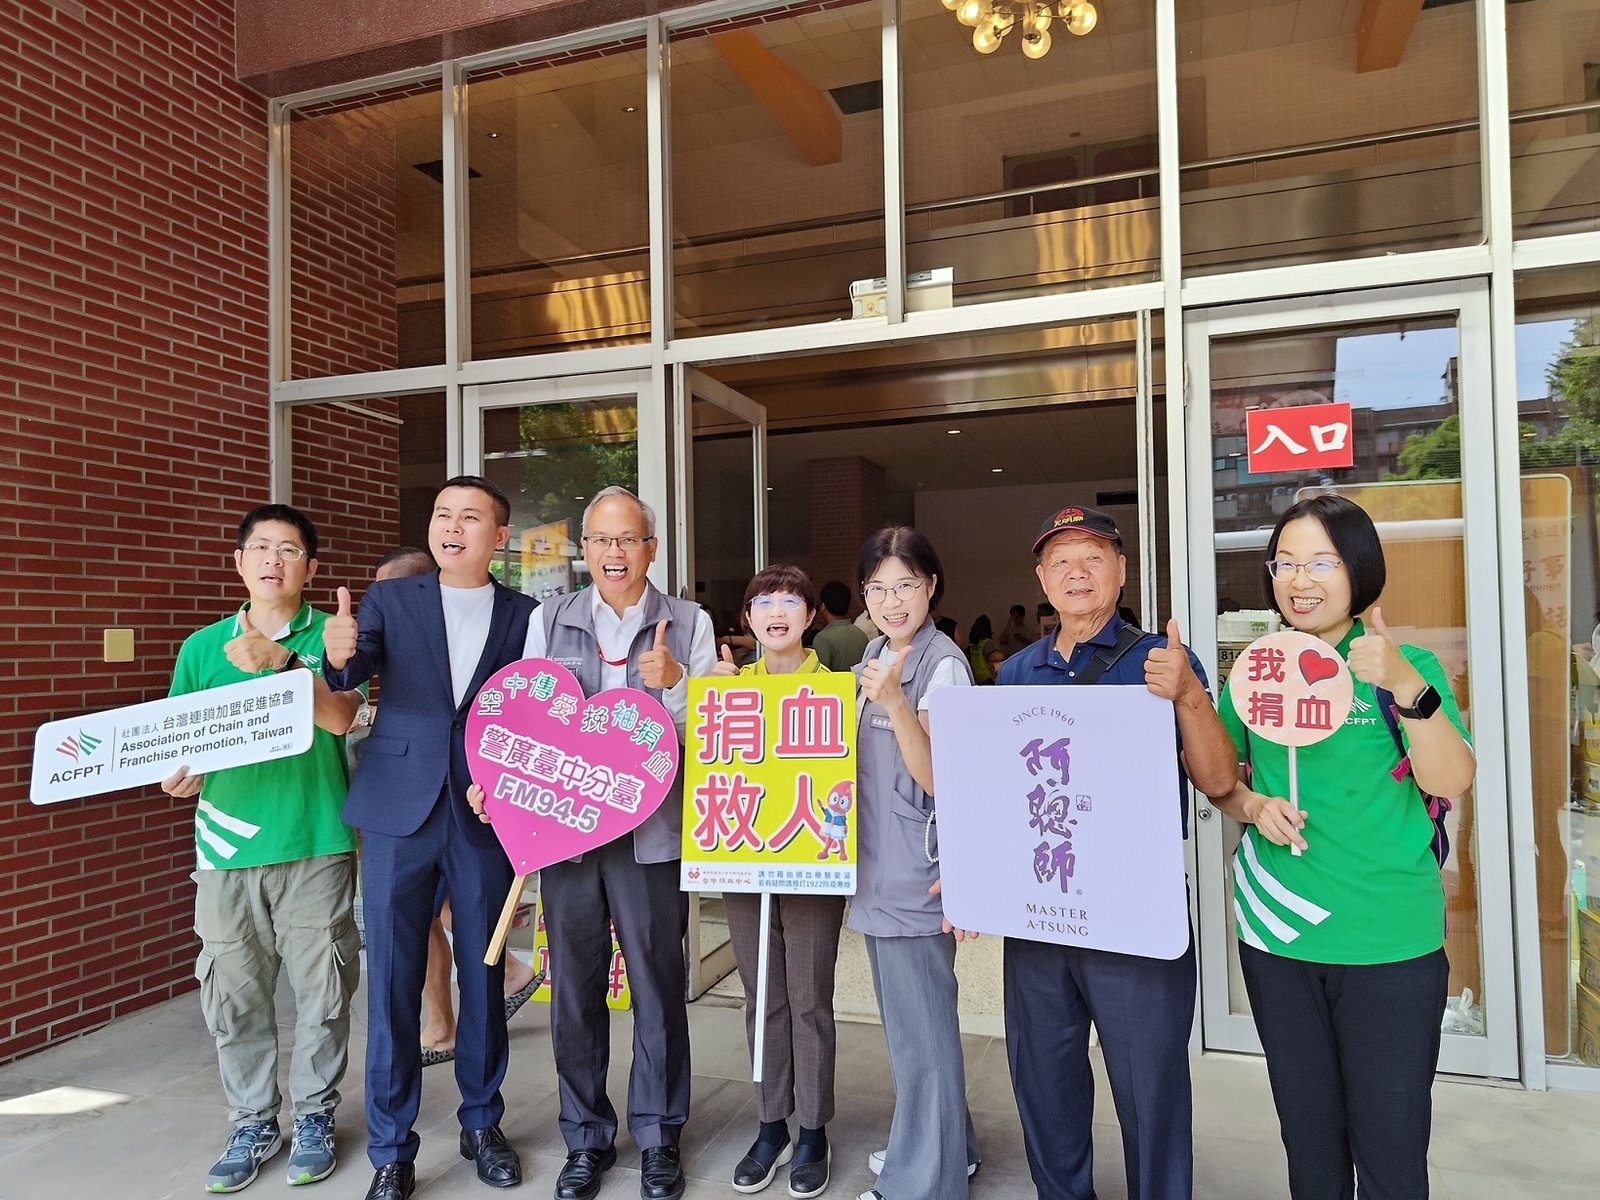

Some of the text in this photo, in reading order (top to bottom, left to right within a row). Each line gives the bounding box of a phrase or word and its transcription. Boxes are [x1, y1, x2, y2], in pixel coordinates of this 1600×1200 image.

[1252, 421, 1348, 455] 入口
[1248, 648, 1286, 682] 我
[162, 689, 295, 730] 台灣連鎖加盟促進協會
[697, 687, 847, 762] 捐血
[1012, 706, 1076, 726] SINCE 1960
[1248, 691, 1333, 730] 捐血
[1342, 717, 1377, 726] CFPT
[119, 748, 178, 768] Franchise
[181, 735, 247, 756] Promotion,
[250, 725, 293, 742] Taiwan
[120, 713, 270, 753] Association of Chain and
[49, 764, 105, 785] ACFPT
[479, 725, 645, 812] 警廣臺中分臺
[493, 774, 601, 833] FM94.5
[694, 774, 841, 850] 救人
[1026, 903, 1088, 920] MASTER
[1026, 919, 1089, 936] A-TSUNG
